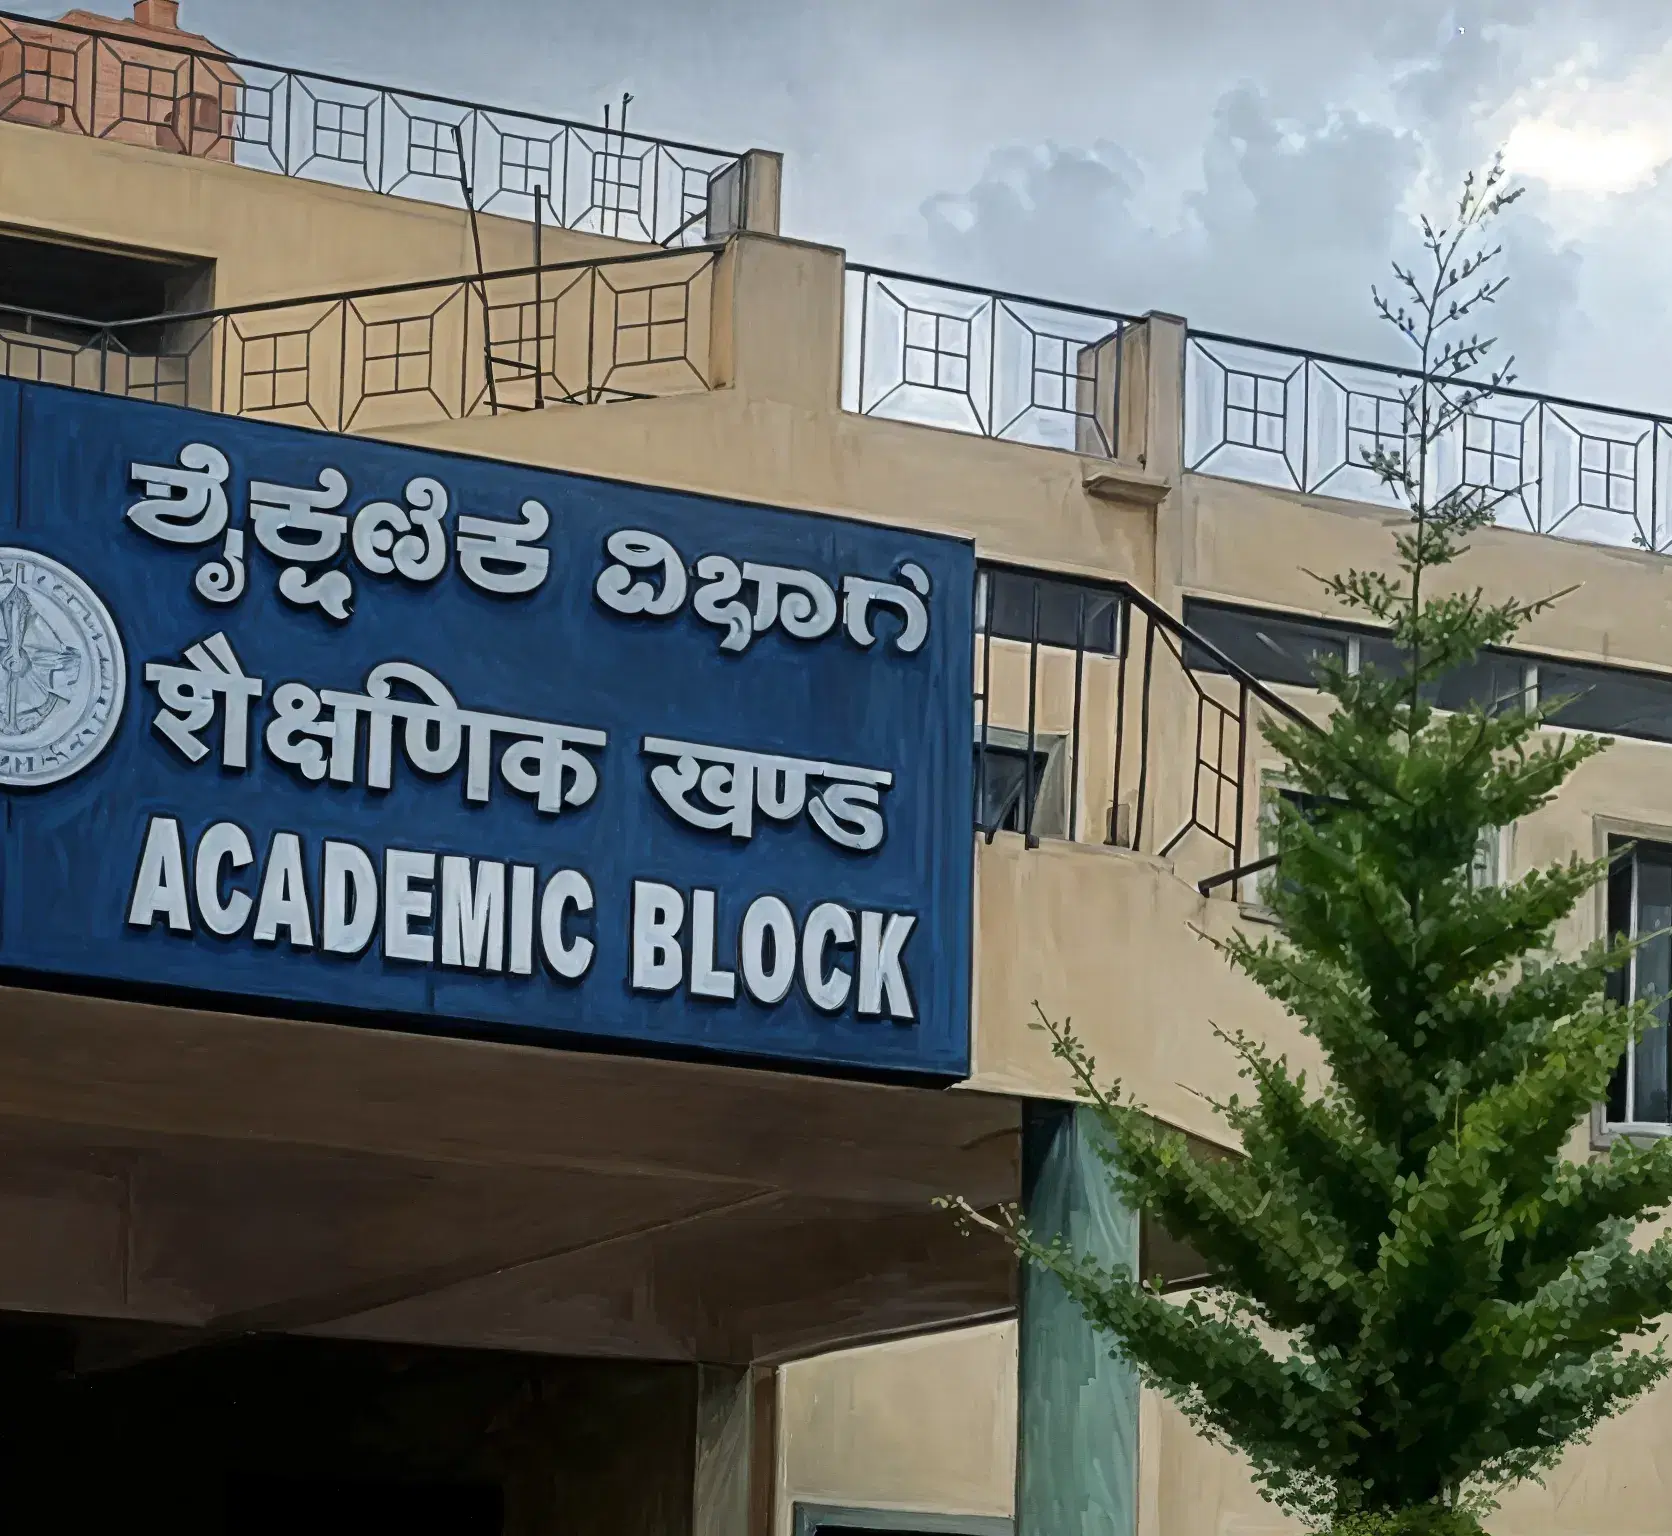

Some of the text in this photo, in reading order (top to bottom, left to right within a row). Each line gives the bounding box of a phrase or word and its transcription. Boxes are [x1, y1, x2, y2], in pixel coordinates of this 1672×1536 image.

[126, 443, 930, 652] ಶೈಕ್ಷಣಿಕ ವಿಭಾಗ
[145, 631, 607, 813] शैक्षणिक
[643, 736, 893, 850] खण्ड
[128, 817, 916, 1019] ACADEMIC BLOCK
